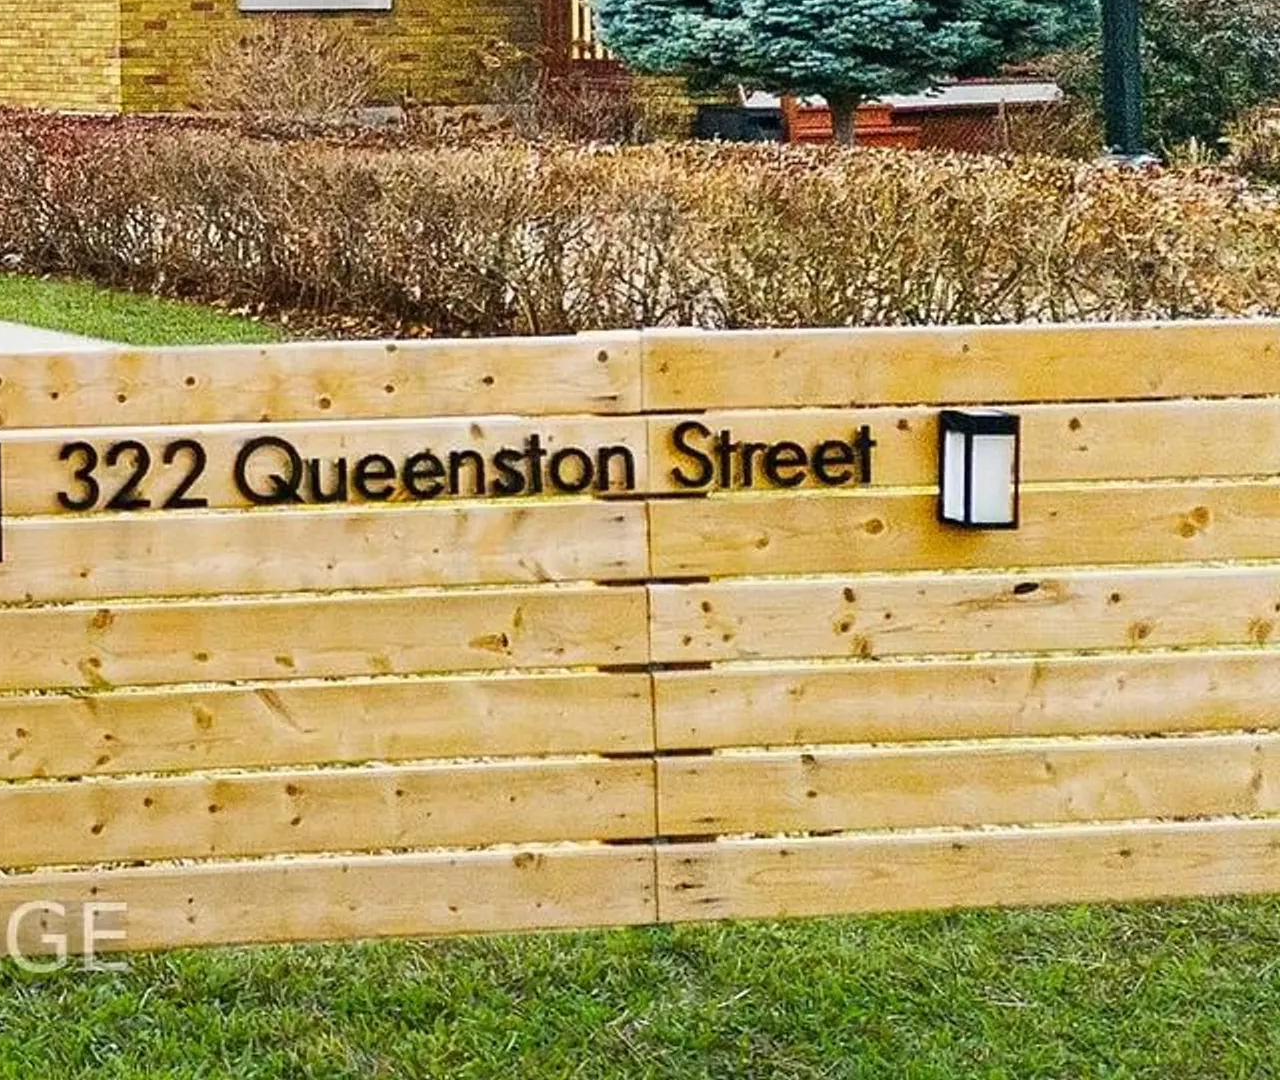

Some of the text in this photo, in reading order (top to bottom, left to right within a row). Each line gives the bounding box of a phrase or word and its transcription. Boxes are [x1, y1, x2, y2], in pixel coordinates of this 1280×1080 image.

[56, 420, 878, 511] 322 Queenston Street
